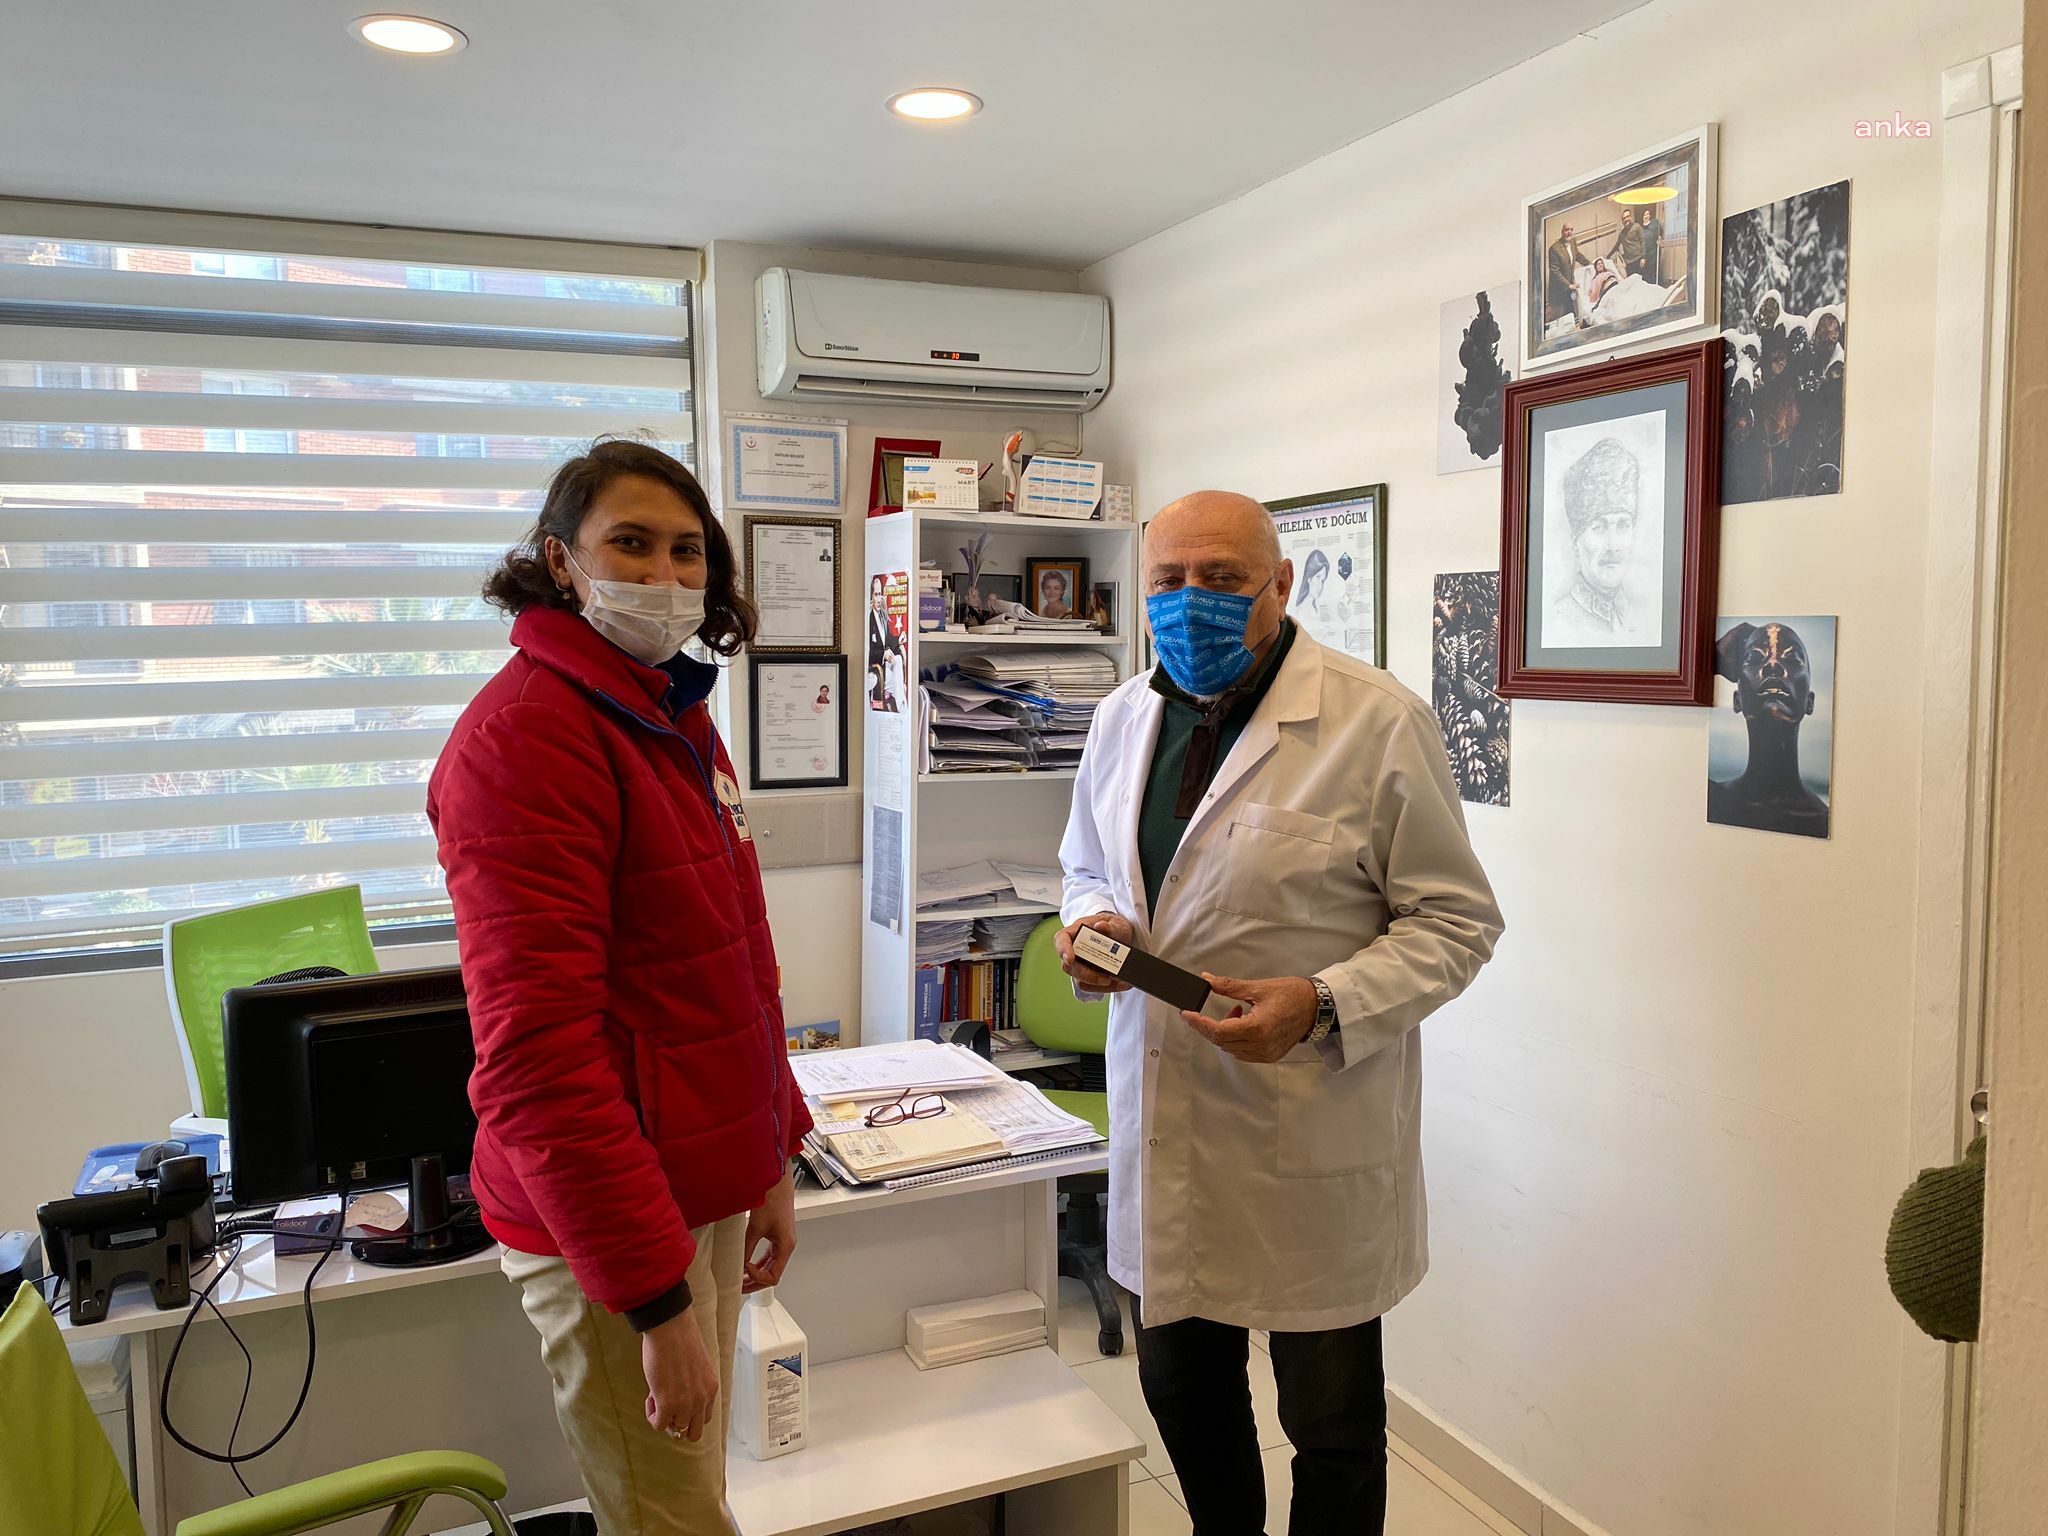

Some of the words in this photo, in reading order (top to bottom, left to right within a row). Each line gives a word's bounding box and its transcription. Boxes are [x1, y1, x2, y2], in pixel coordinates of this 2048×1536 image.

[1277, 518, 1312, 534] MİLELİK
[1315, 517, 1328, 529] VE
[1331, 510, 1368, 527] DOĞUM
[276, 1220, 308, 1229] Folidoce
